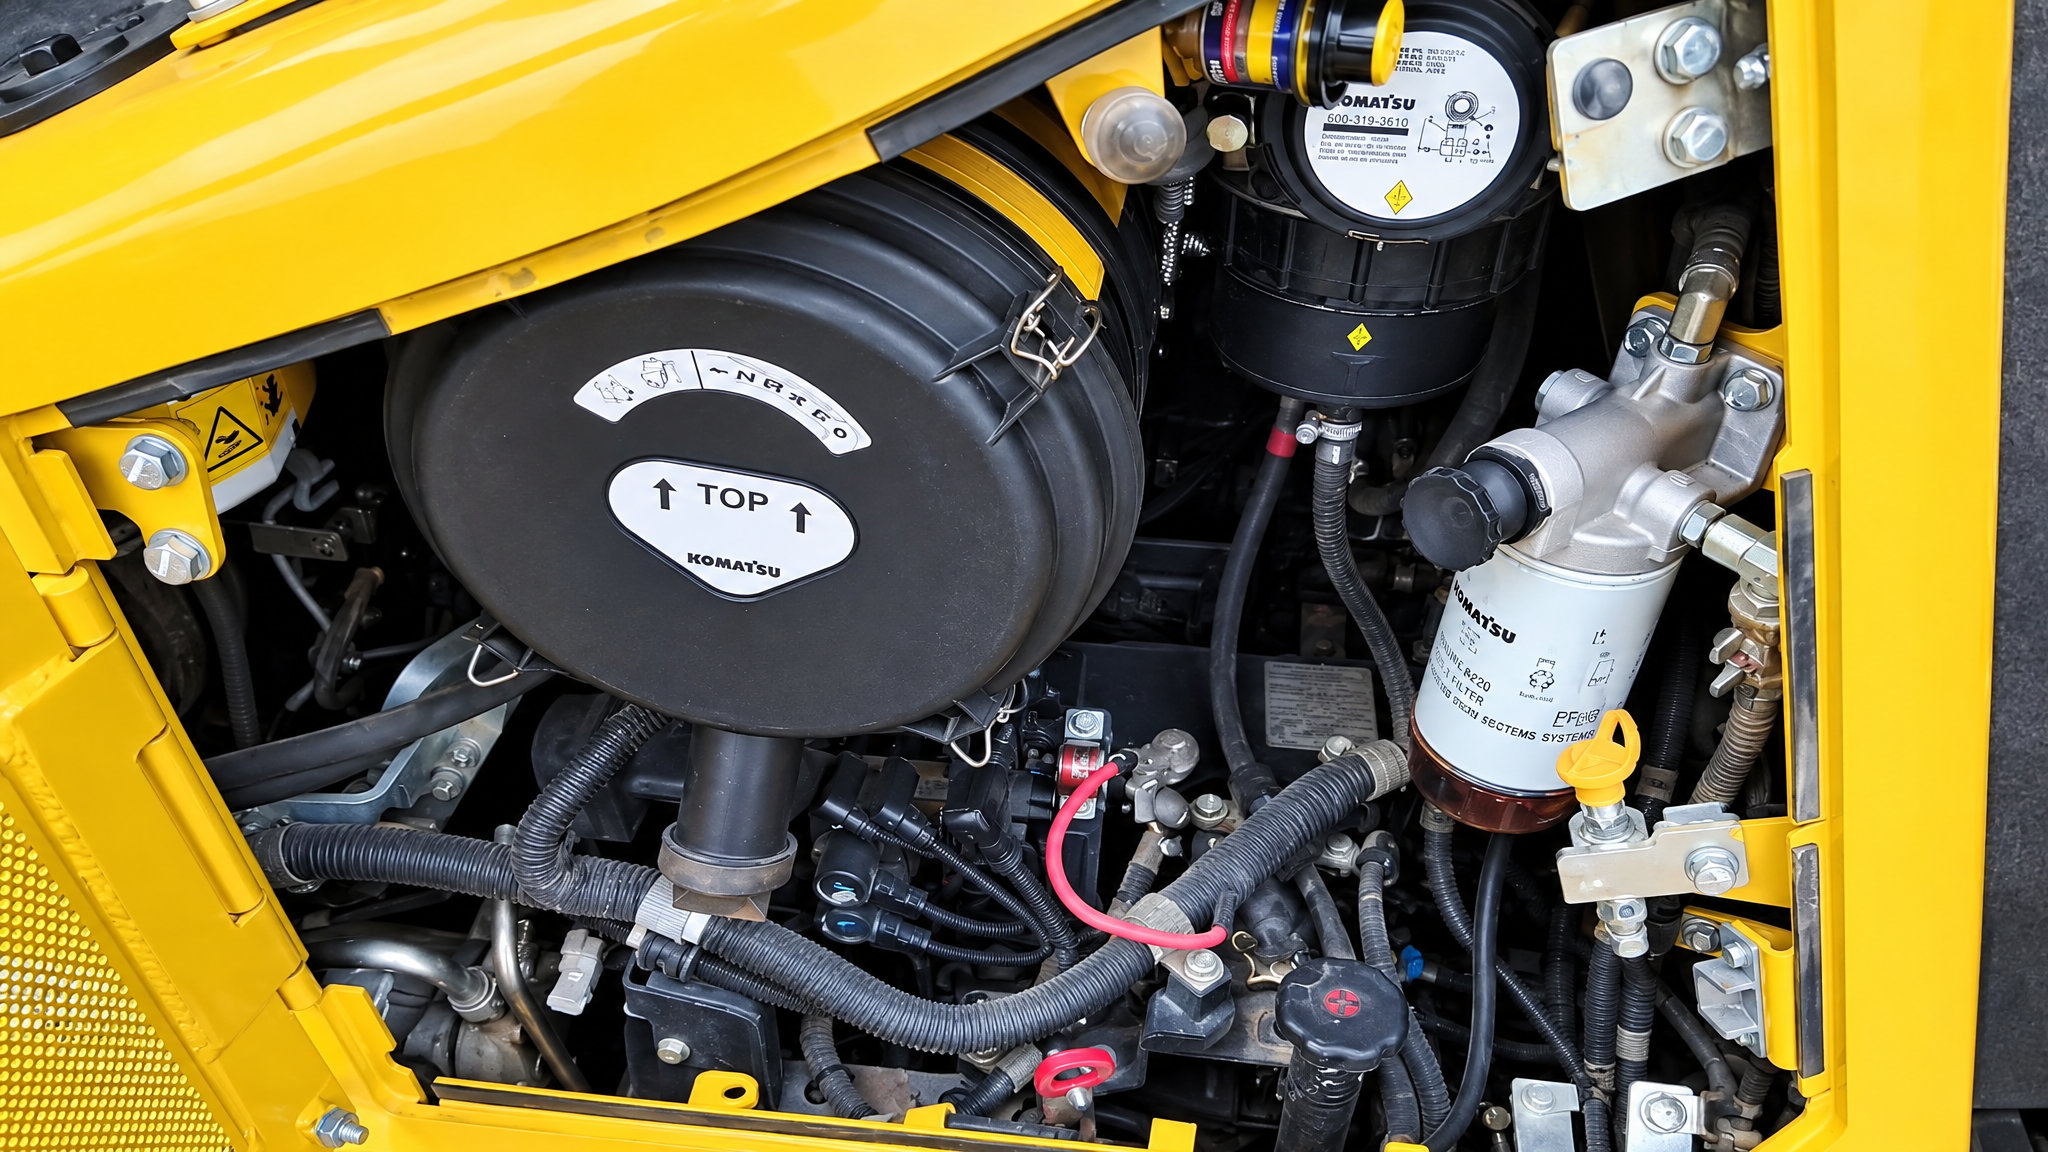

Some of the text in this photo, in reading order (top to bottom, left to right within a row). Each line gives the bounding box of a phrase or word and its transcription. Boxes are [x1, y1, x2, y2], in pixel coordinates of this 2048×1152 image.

[1337, 94, 1416, 111] OMATSU
[1327, 113, 1409, 127] 600-319-3610
[697, 483, 769, 511] TOP
[687, 552, 781, 578] KOMATSU
[1454, 579, 1517, 644] KOMATSU
[1451, 675, 1484, 706] FILTER
